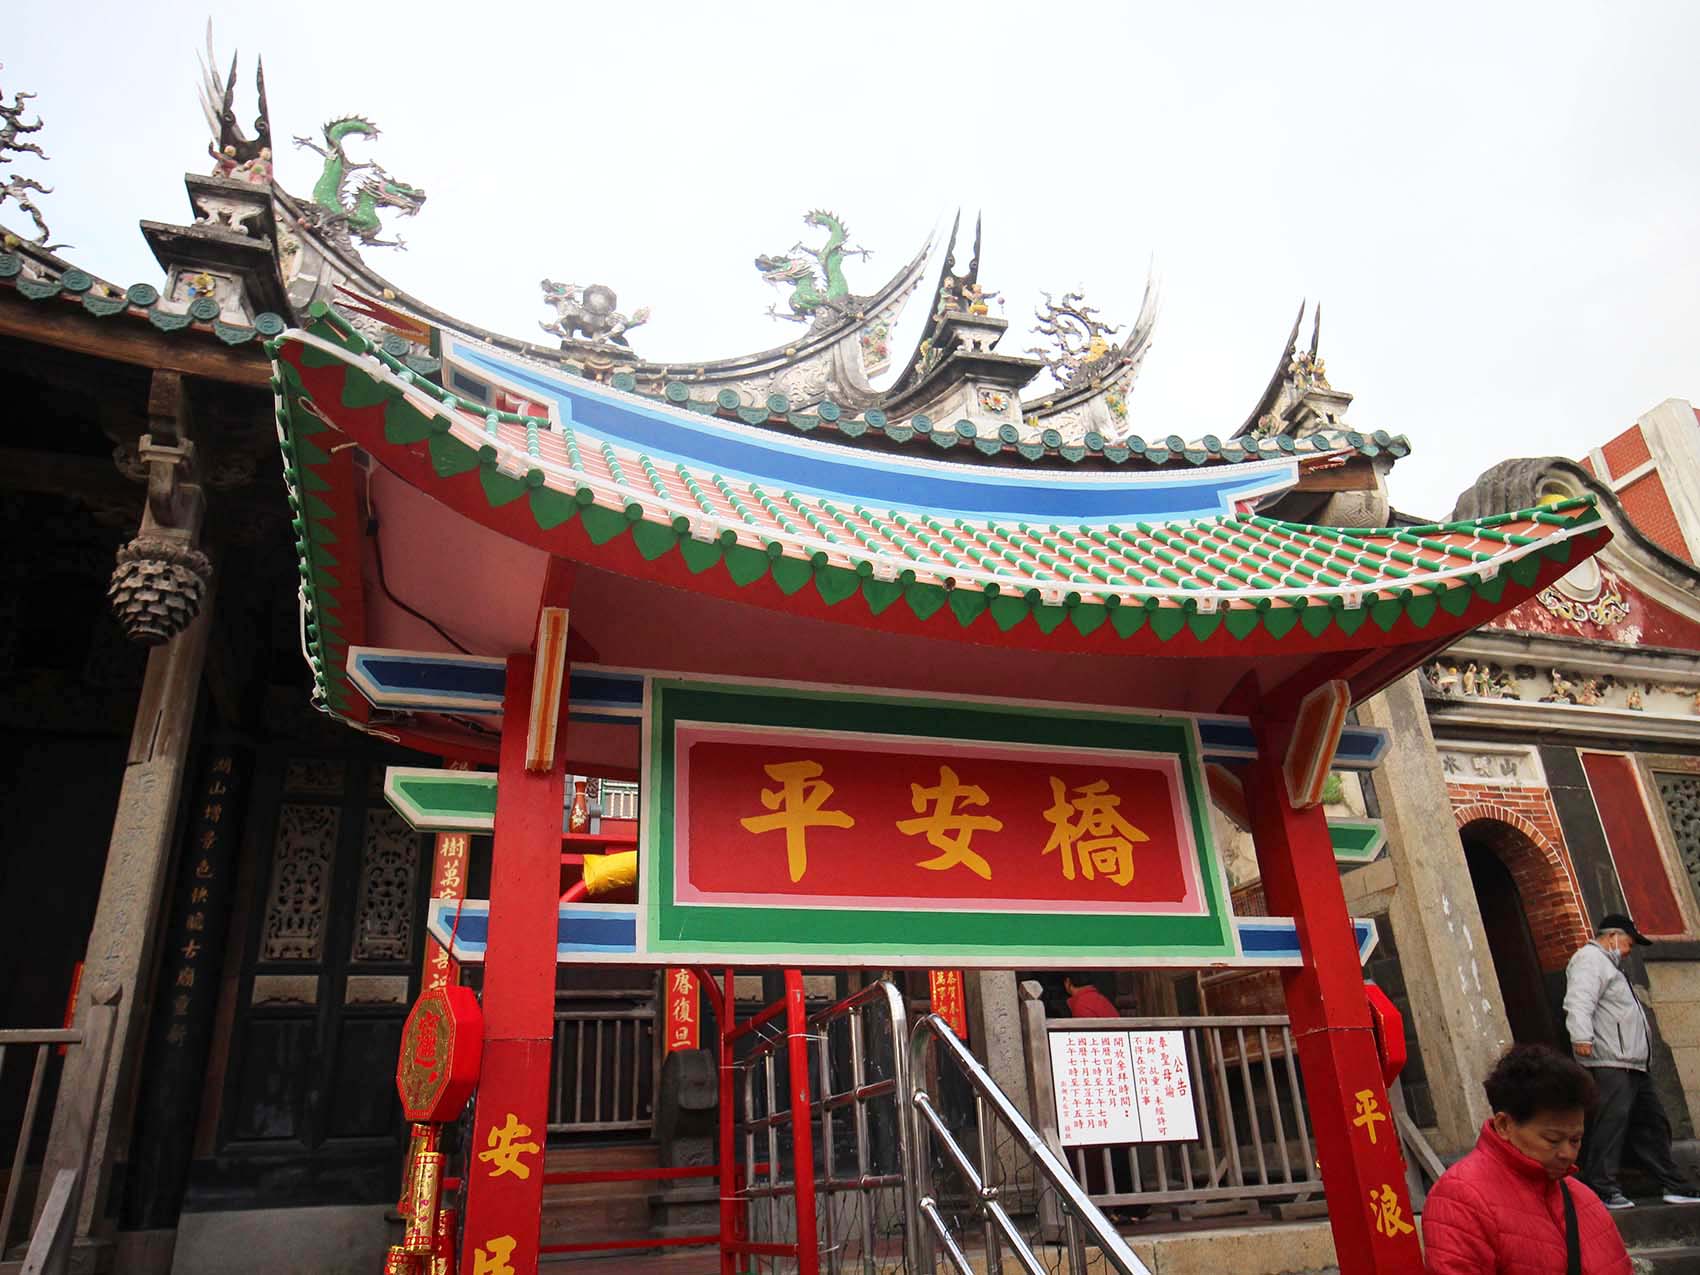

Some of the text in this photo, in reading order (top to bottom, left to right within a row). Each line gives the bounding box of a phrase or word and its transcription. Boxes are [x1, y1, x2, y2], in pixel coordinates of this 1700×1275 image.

[740, 760, 1151, 887] 平安橋
[1173, 1055, 1187, 1097] 公告
[1352, 1088, 1415, 1239] 平浪
